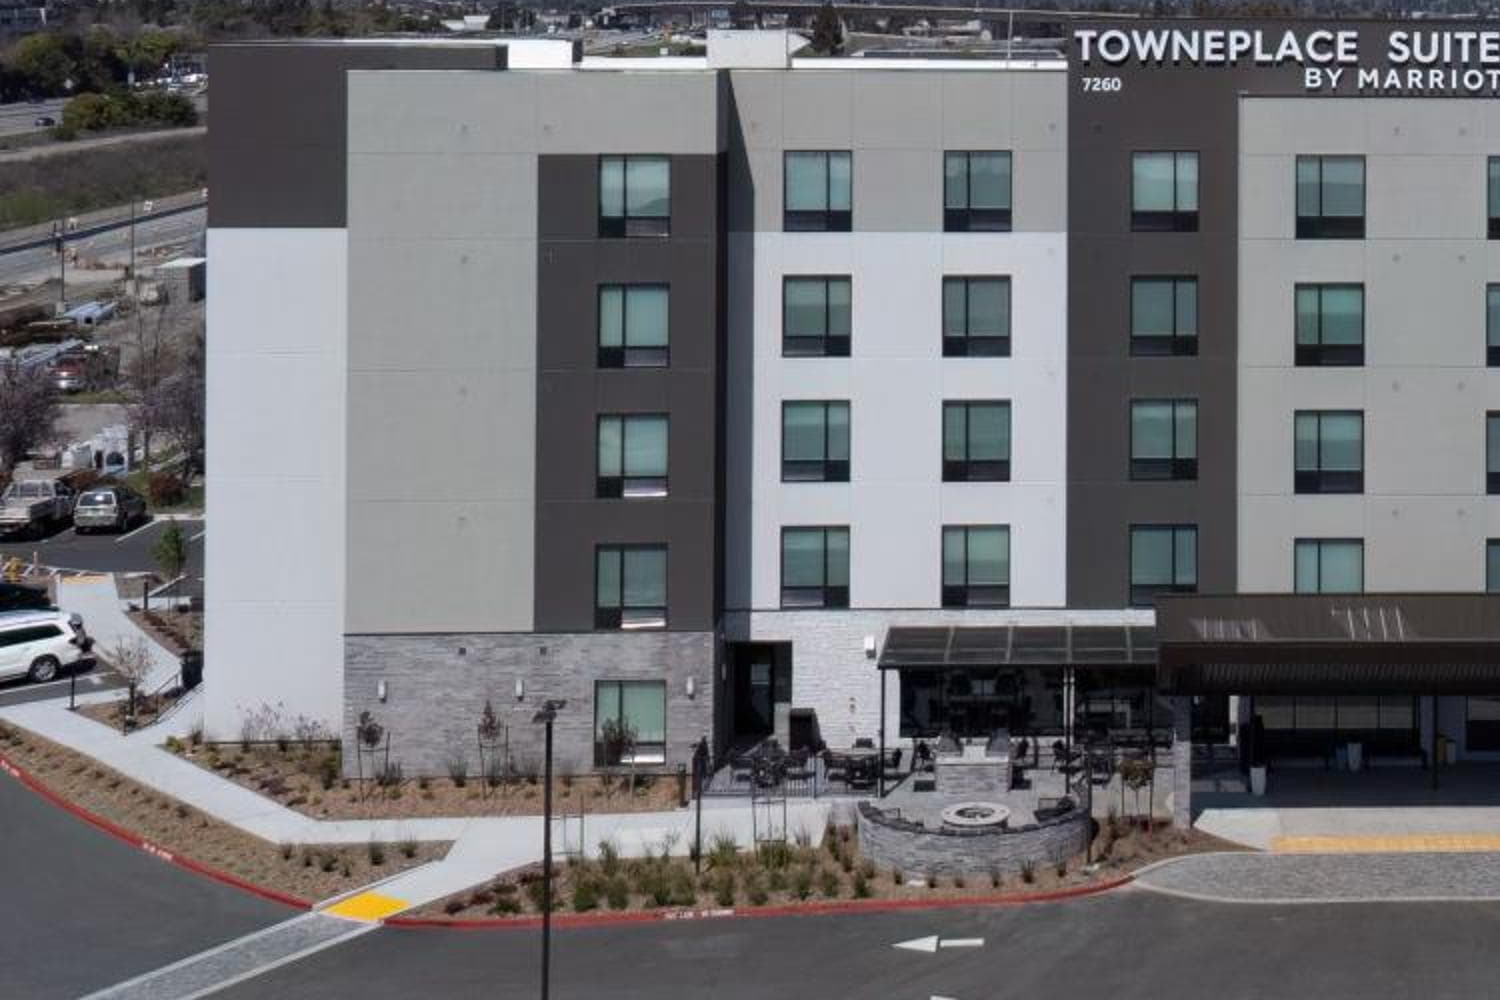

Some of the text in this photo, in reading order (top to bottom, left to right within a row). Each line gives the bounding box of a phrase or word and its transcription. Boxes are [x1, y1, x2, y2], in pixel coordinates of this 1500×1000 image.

[1074, 30, 1358, 62] TOWNEPLACE
[1082, 77, 1121, 92] 7260
[1305, 68, 1342, 89] BY
